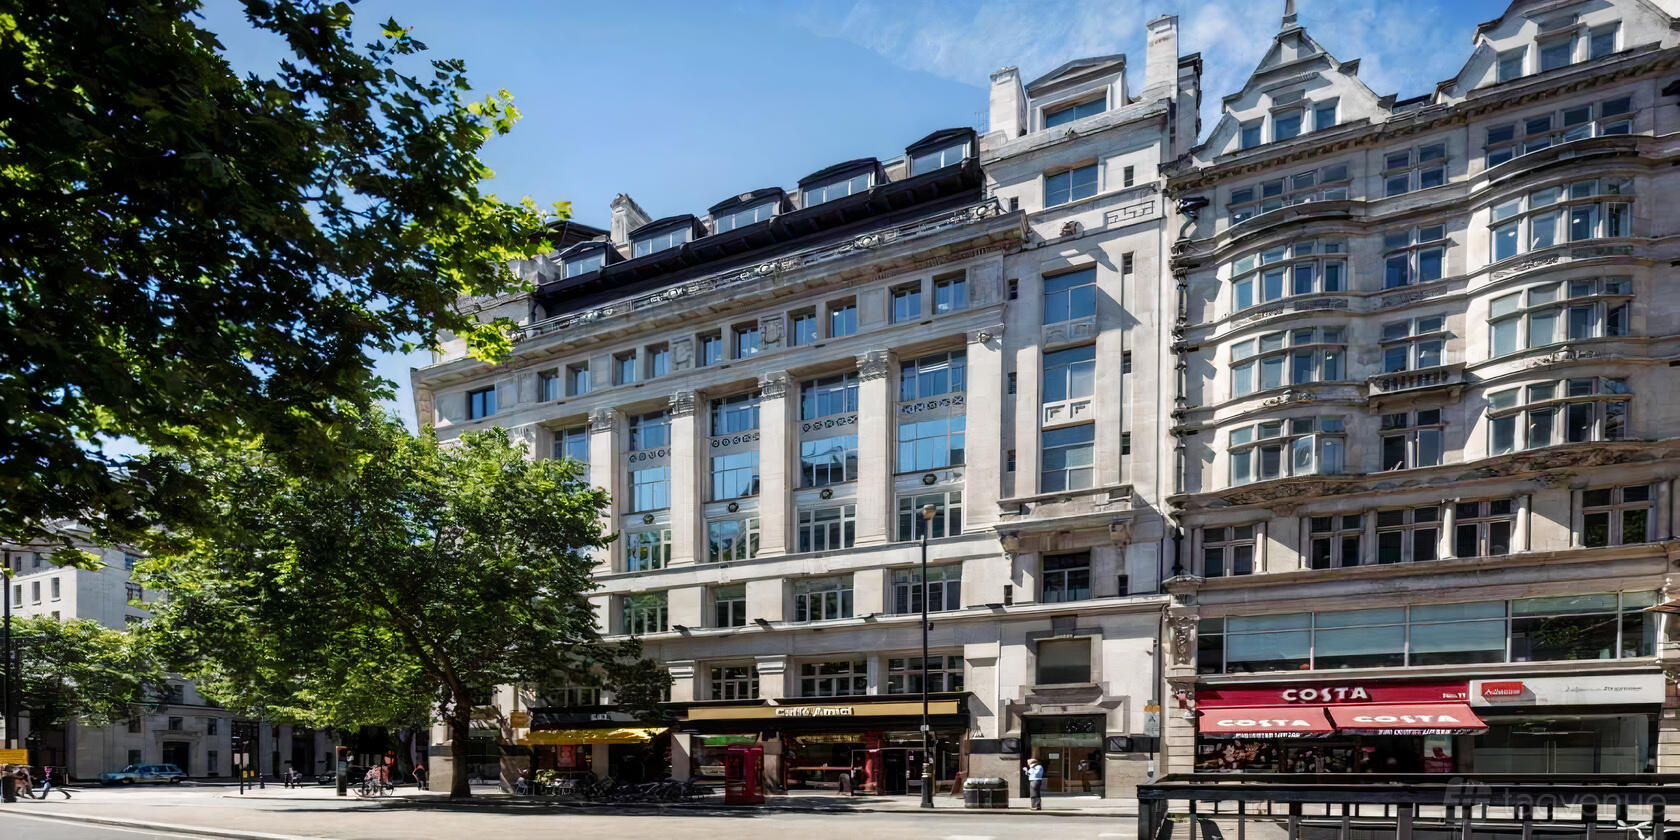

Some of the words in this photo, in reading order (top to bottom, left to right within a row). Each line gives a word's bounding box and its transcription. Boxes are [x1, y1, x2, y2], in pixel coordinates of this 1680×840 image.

[1282, 687, 1368, 702] COSTA
[1217, 719, 1311, 727] COSTA
[1352, 715, 1461, 723] COSTA
